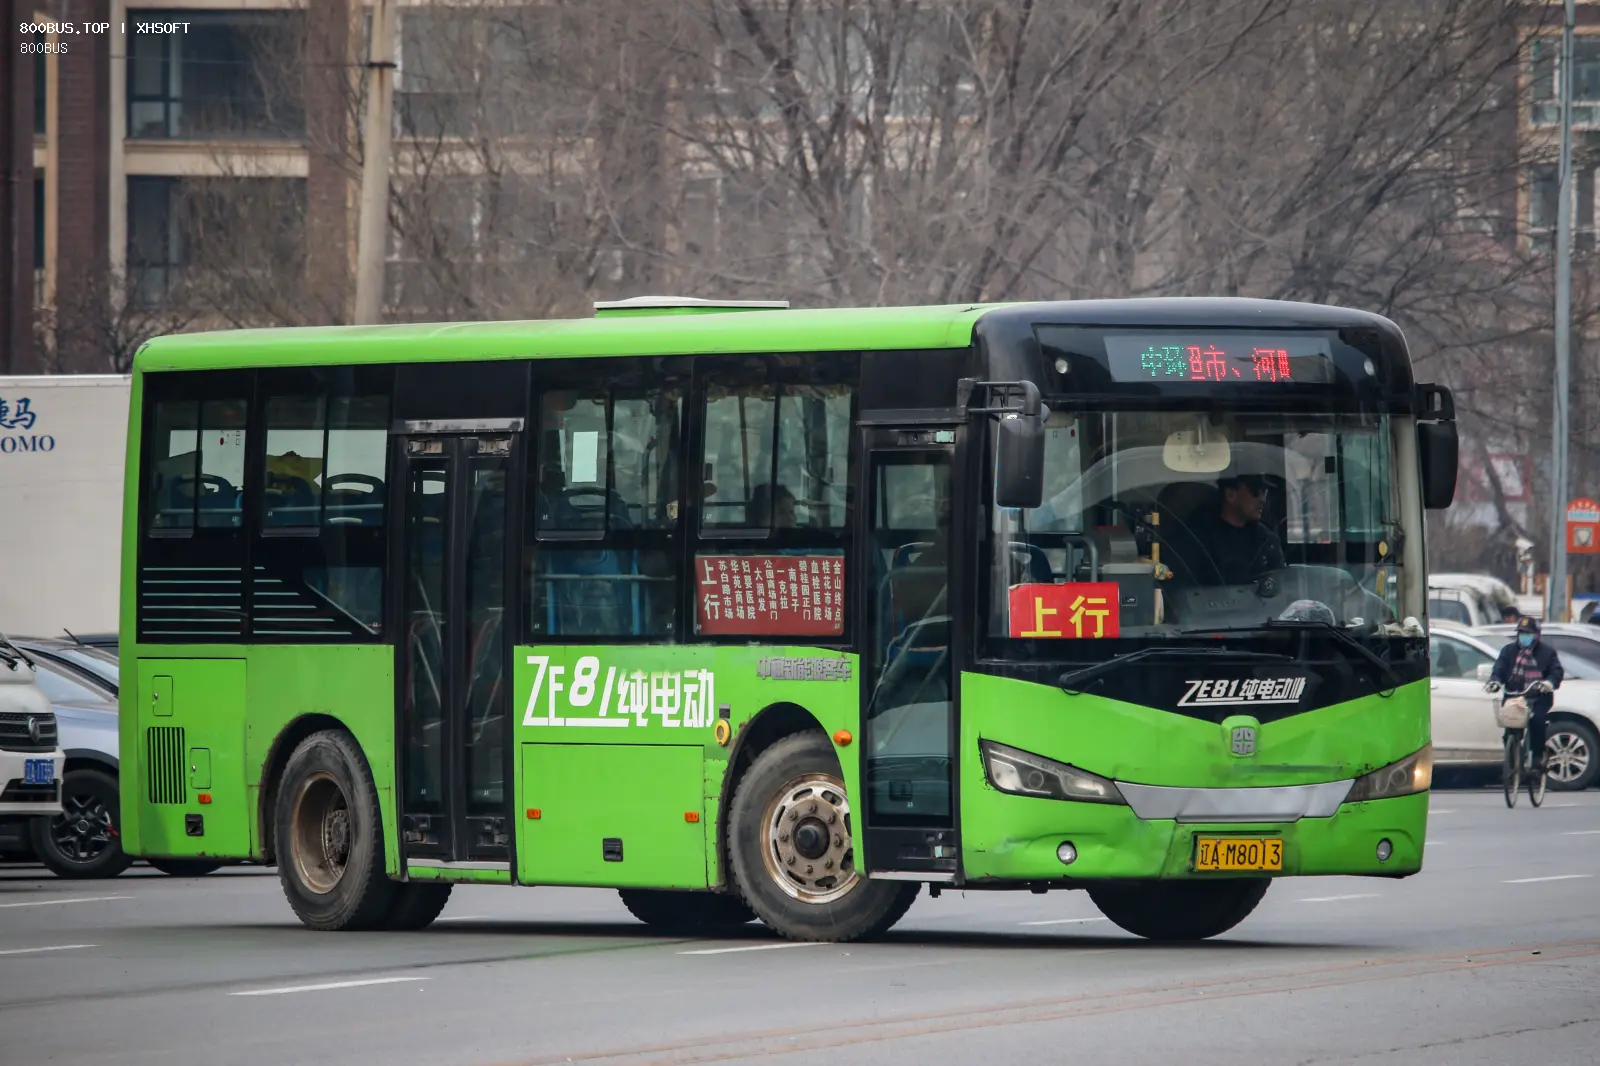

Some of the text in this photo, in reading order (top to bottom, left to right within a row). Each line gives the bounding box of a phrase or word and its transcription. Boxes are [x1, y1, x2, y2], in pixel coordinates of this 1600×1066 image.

[701, 560, 720, 620] 上行
[731, 560, 745, 619] 华苑商场
[741, 560, 756, 619] 妇婴医院
[754, 567, 767, 612] 大润发
[776, 569, 789, 609] 一克拉
[788, 567, 799, 612] 南营子
[798, 560, 811, 620] 碧桂园正门
[811, 560, 822, 620] 血栓医院
[822, 560, 832, 620] 桂花市场
[833, 560, 842, 621] 金山终点
[1020, 595, 1110, 638] 上行
